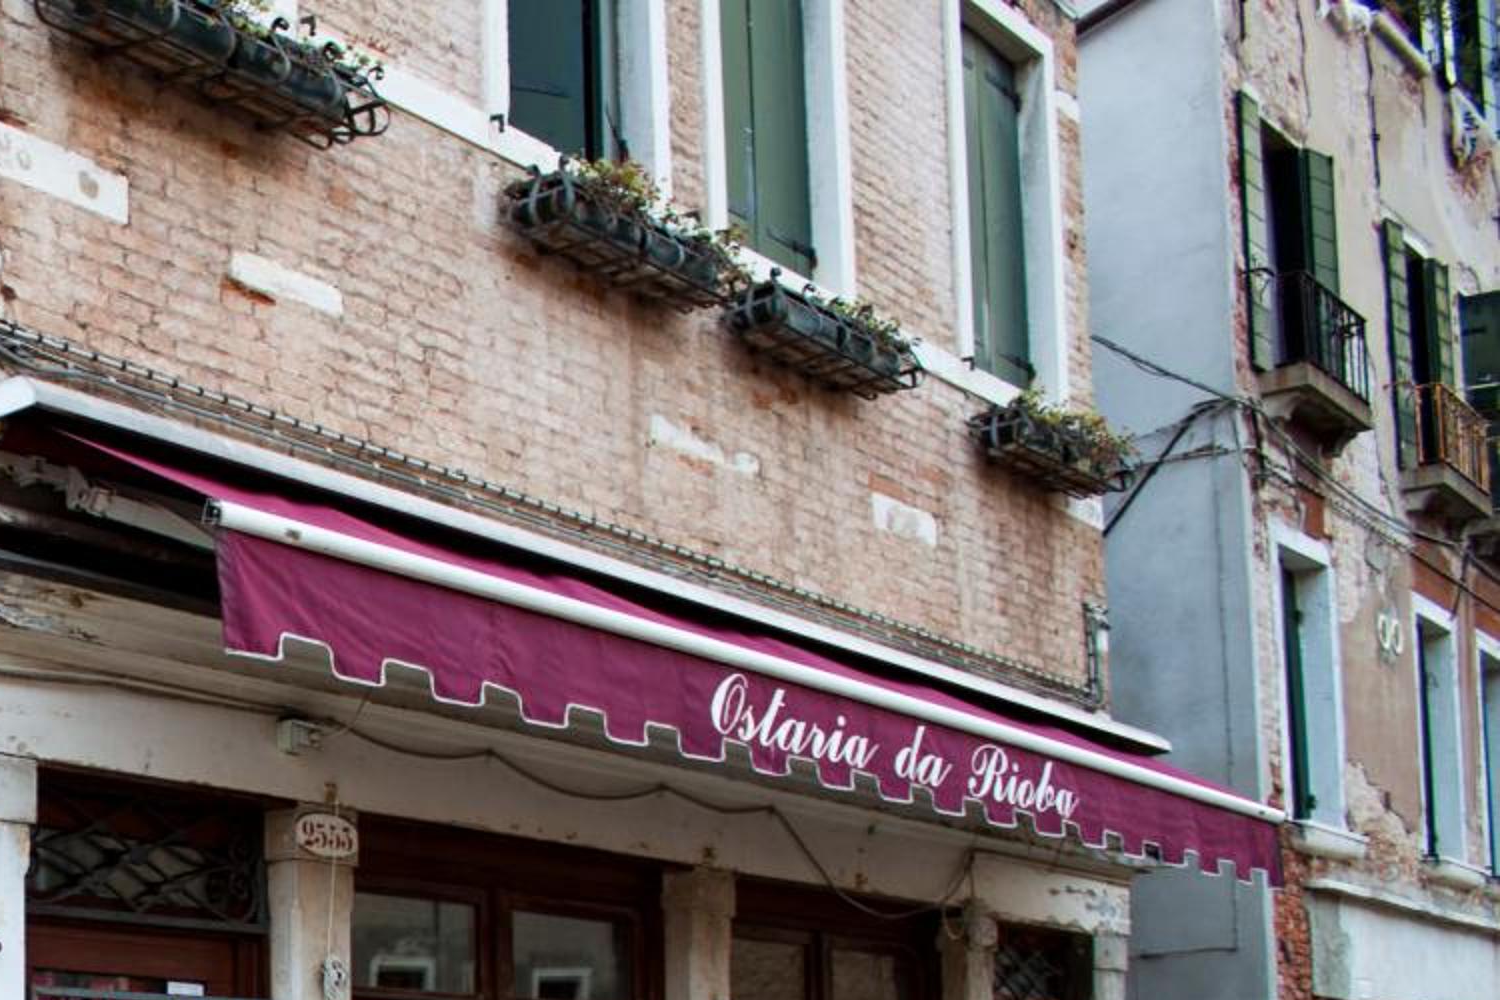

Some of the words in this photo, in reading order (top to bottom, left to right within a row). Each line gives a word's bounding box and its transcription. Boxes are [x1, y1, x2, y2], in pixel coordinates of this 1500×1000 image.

[711, 673, 878, 769] Ostaria
[895, 725, 952, 788] da
[968, 744, 1079, 818] Rioba
